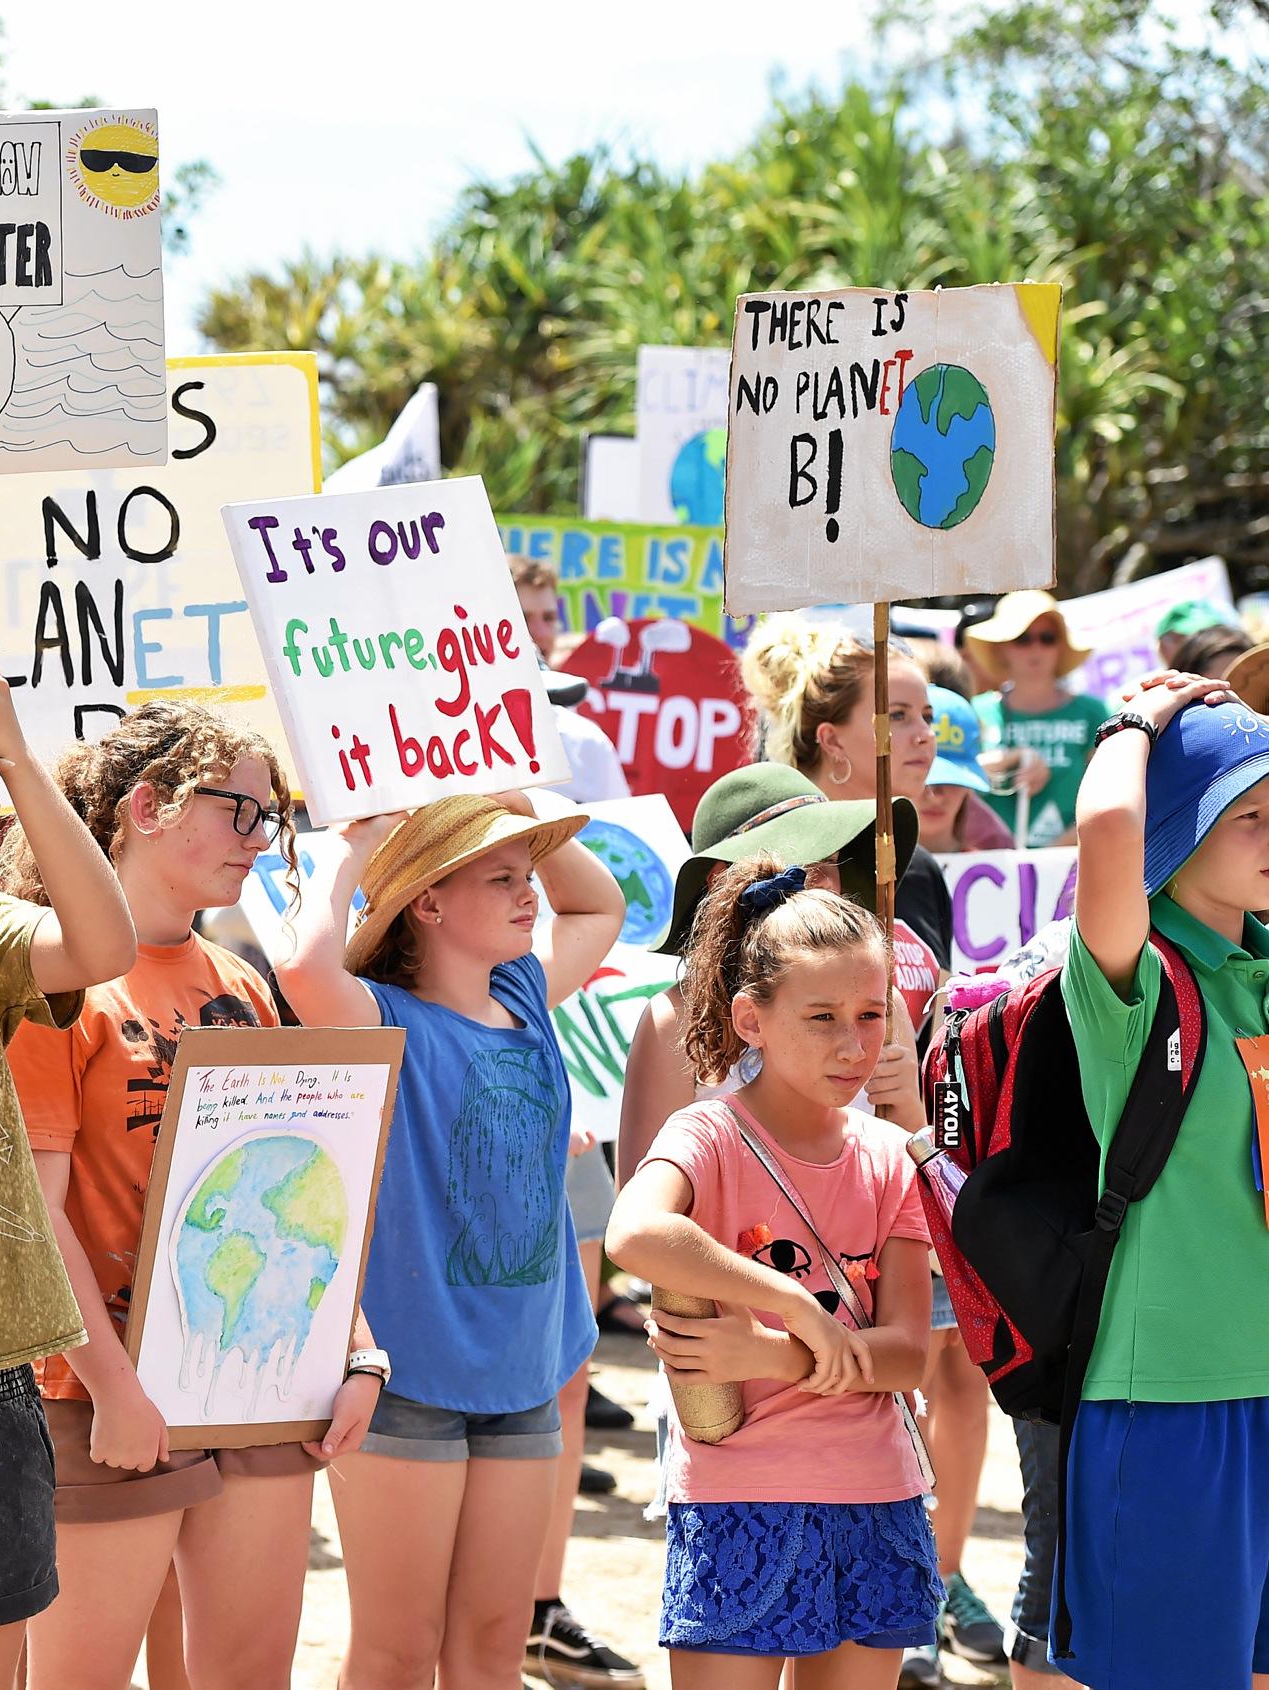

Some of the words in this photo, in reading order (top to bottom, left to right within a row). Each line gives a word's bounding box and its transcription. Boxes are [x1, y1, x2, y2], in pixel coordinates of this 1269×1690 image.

[744, 299, 845, 351] THERE
[872, 294, 908, 337] IS
[736, 372, 779, 416] NO
[796, 349, 915, 421] PLANET
[171, 381, 217, 460] S
[789, 428, 844, 543] B!
[42, 485, 181, 568] NO
[248, 515, 346, 583] It's
[368, 511, 446, 566] our
[645, 536, 689, 585] IS
[331, 724, 374, 791] it
[388, 688, 541, 779] back!
[196, 1097, 219, 1118] being
[255, 1091, 275, 1105] And
[280, 1088, 292, 1102] the
[296, 1090, 323, 1104] people
[326, 1088, 343, 1100] who
[221, 1068, 250, 1091] Earth
[194, 1114, 220, 1129] killing
[238, 1110, 259, 1121] have
[263, 1112, 287, 1121] names
[287, 1109, 308, 1122] and
[943, 1090, 959, 1146] 4YOU
